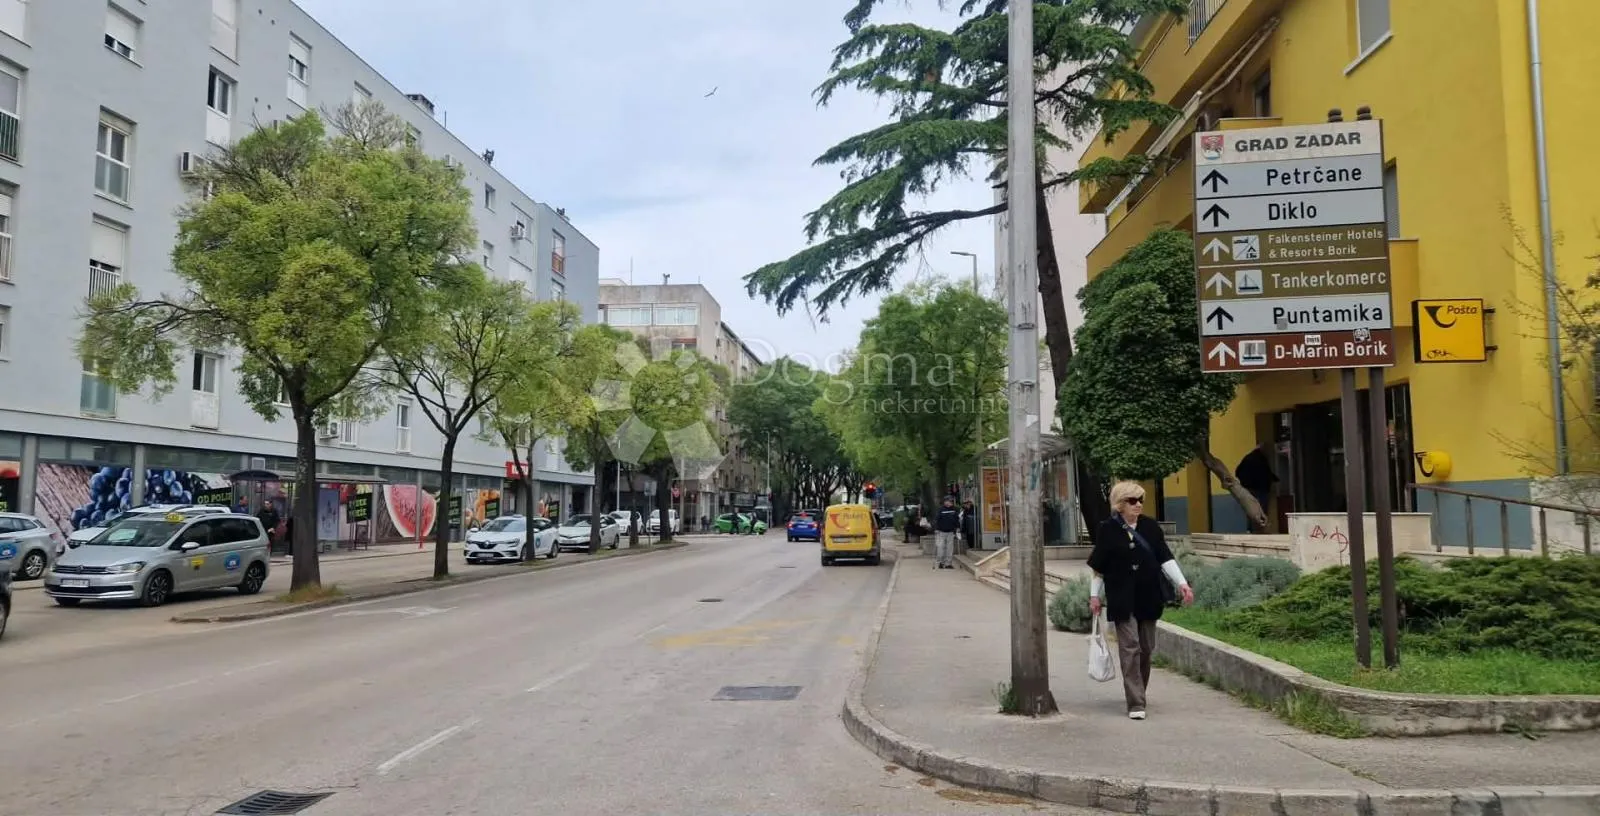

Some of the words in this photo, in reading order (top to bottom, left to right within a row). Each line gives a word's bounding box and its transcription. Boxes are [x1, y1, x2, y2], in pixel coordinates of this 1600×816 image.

[1235, 138, 1288, 152] GRAD
[1295, 132, 1361, 148] ZADAR
[1266, 166, 1362, 186] Petrčane
[1268, 201, 1317, 221] Diklo
[1268, 232, 1343, 244] Falkensteiner
[1347, 229, 1383, 240] Hotels
[1269, 250, 1277, 258] &
[1280, 247, 1325, 258] Resorts
[1328, 245, 1357, 255] Borik
[1272, 271, 1387, 289] Tankerkomerc
[1273, 303, 1383, 324] Puntamika
[1447, 305, 1477, 315] Pošta
[1274, 343, 1338, 359] D-Marin
[1344, 341, 1388, 356] Borik
